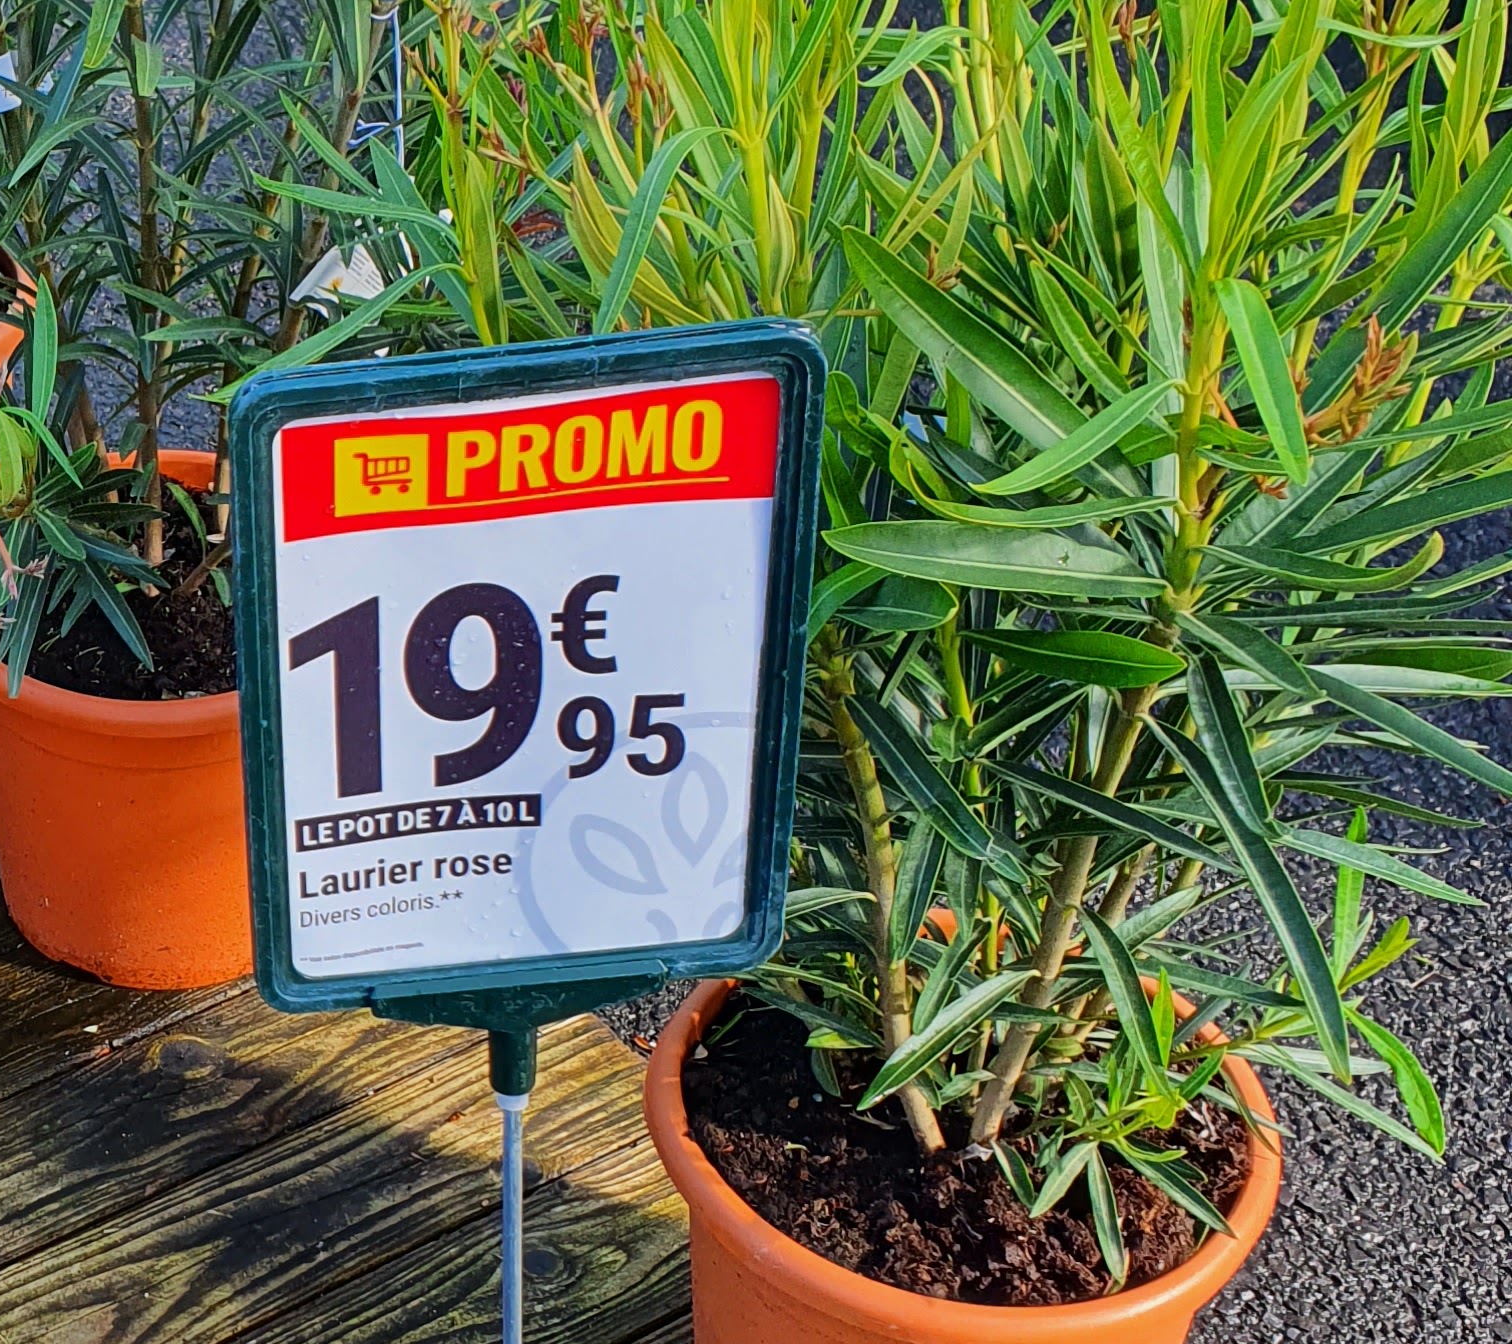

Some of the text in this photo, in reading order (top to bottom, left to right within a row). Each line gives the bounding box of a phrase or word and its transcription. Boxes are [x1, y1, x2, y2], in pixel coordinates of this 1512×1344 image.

[445, 399, 724, 498] PROMO
[287, 574, 686, 799] 19 € 95
[302, 799, 535, 846] LE POT DE 7 À 10 L
[299, 852, 513, 899] Laurier rose
[300, 906, 361, 928] Divers
